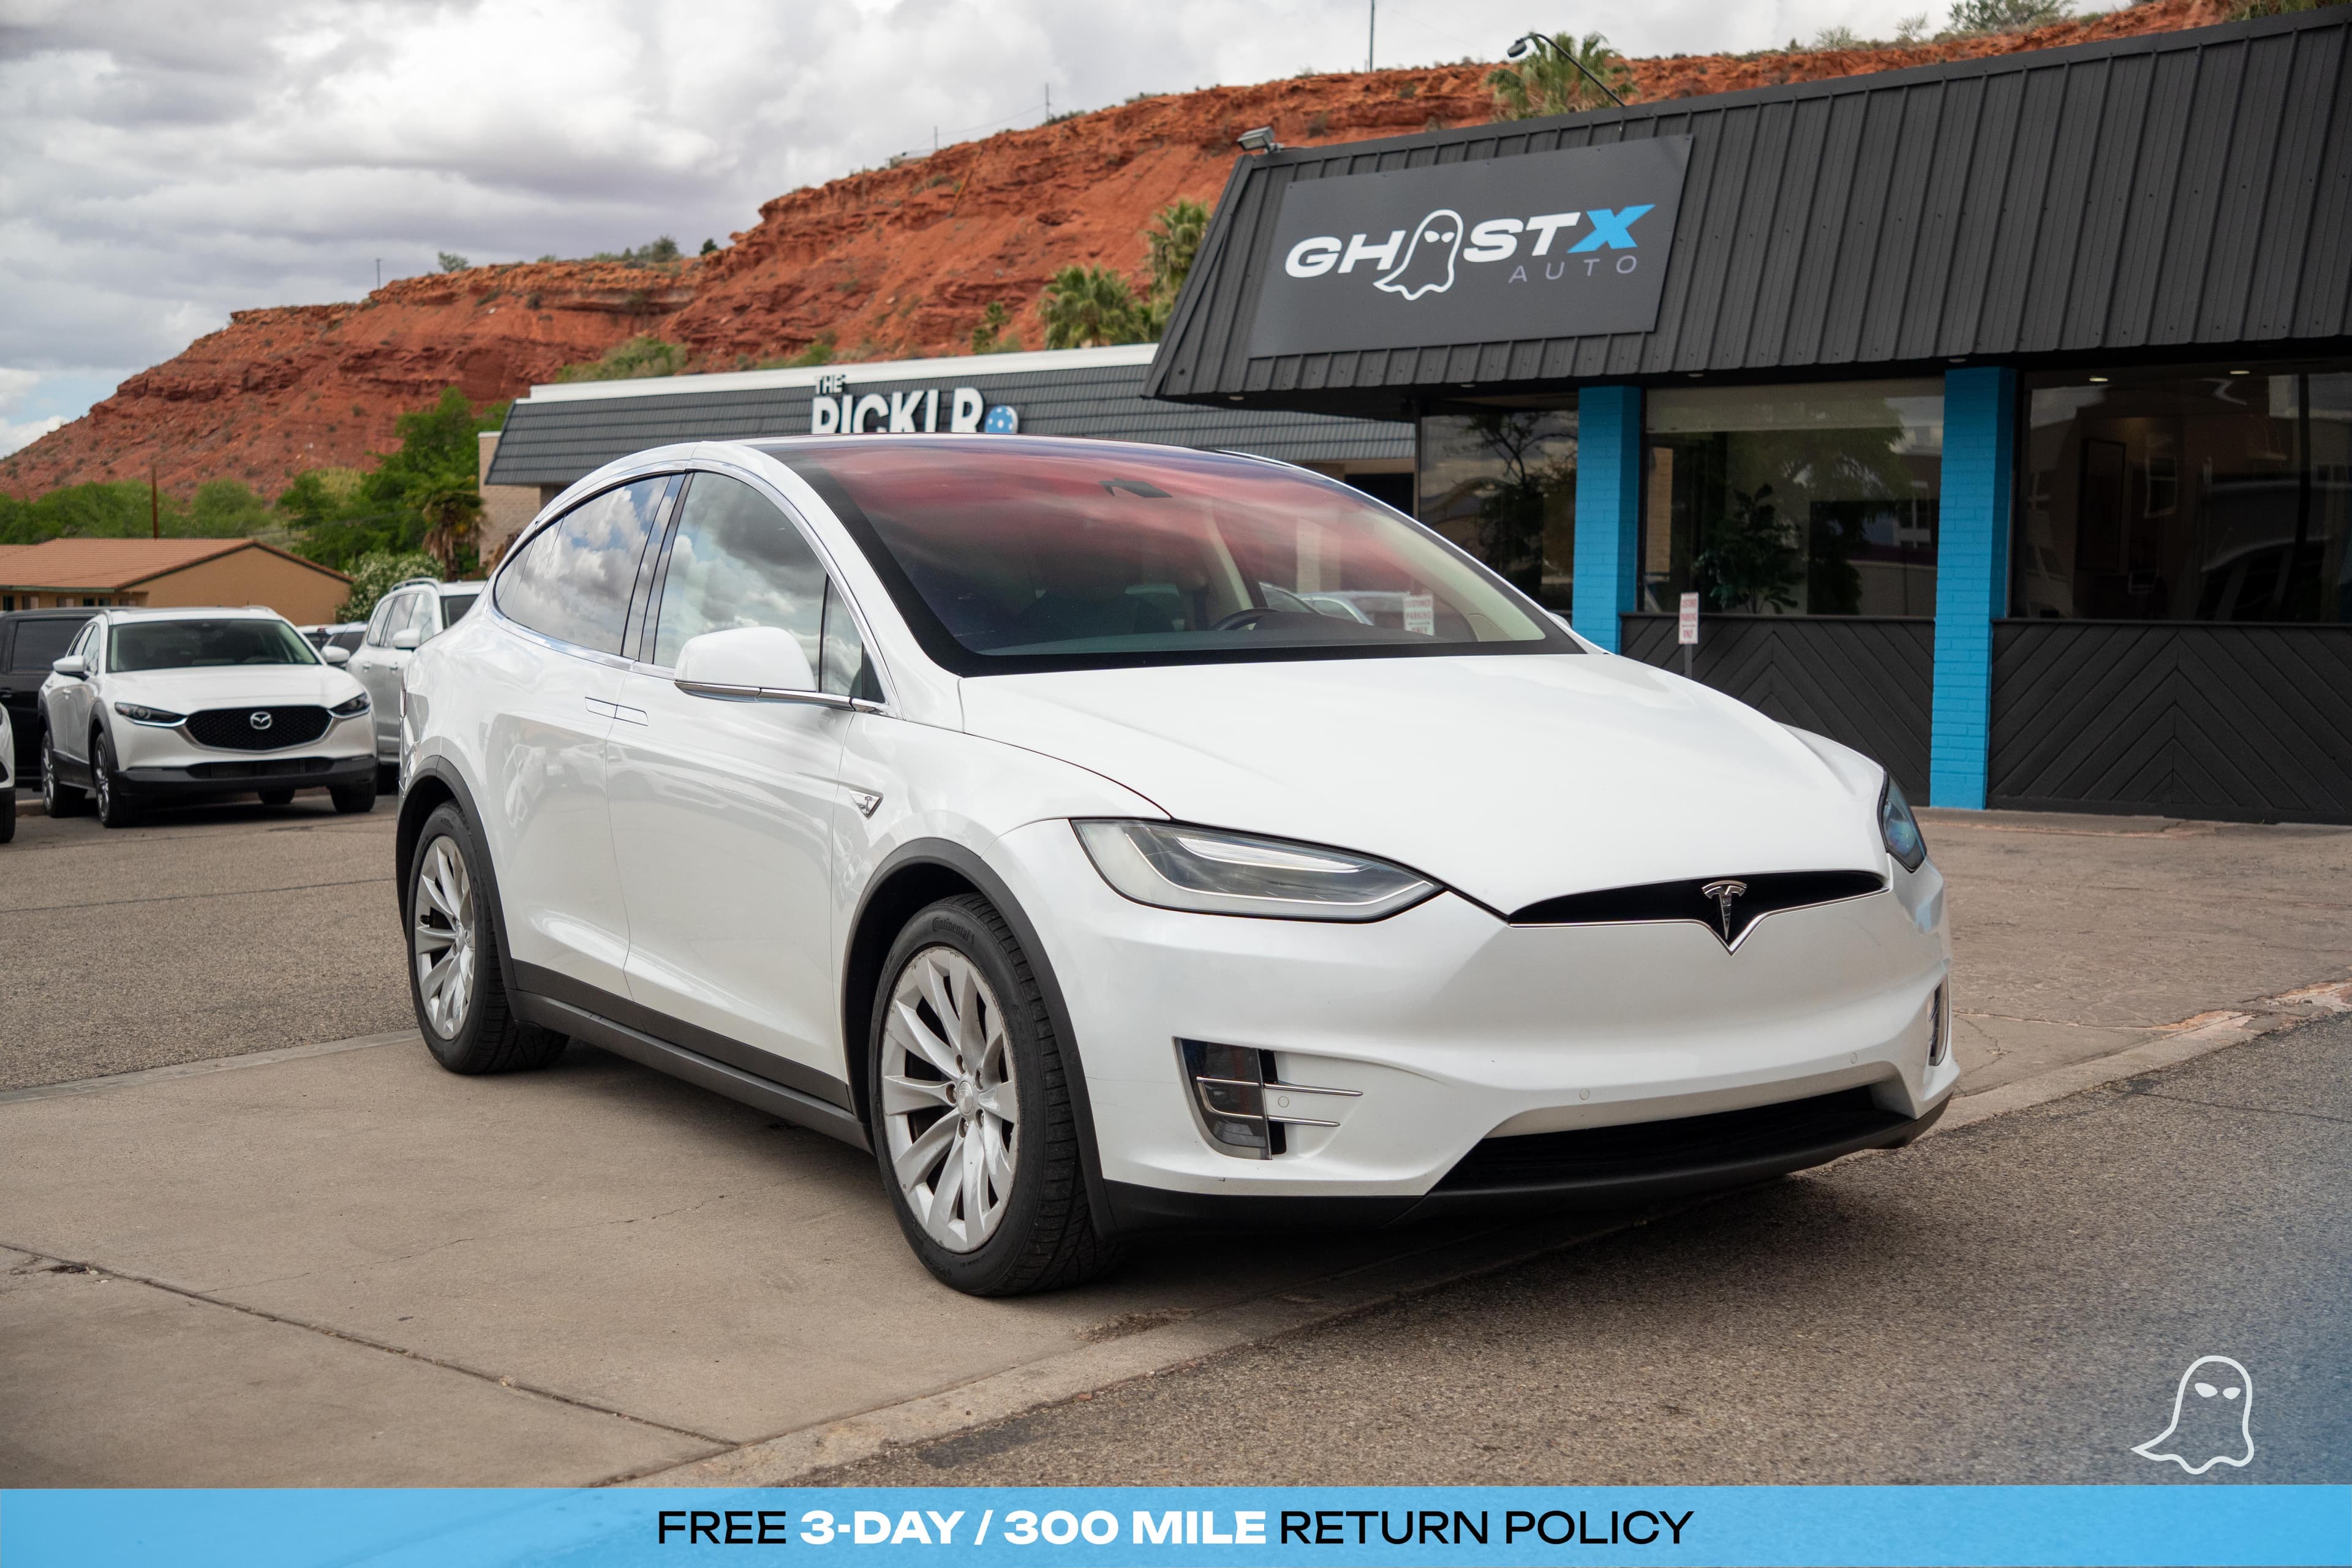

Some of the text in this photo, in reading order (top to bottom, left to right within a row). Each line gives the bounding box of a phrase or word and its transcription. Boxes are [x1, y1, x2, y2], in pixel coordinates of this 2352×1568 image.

[1508, 255, 1637, 284] AUTO
[814, 374, 843, 394] THE
[932, 917, 971, 941] Continental
